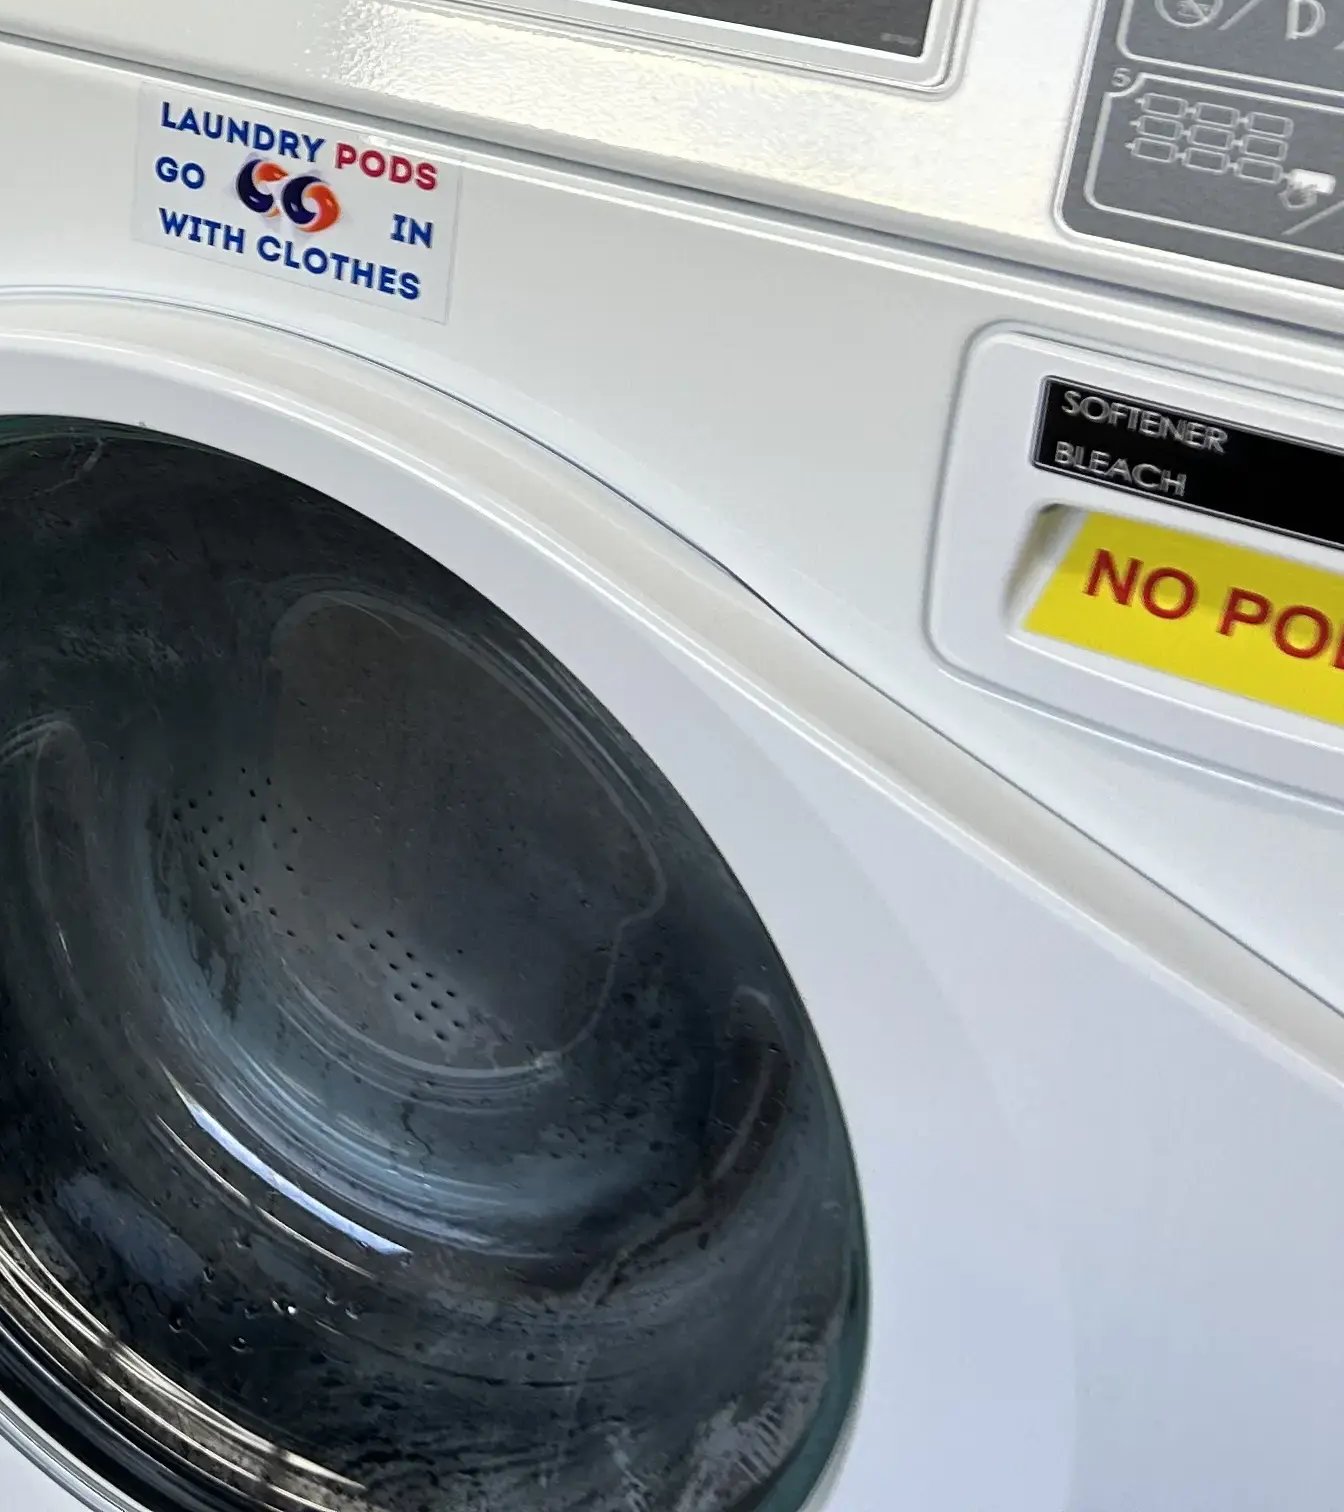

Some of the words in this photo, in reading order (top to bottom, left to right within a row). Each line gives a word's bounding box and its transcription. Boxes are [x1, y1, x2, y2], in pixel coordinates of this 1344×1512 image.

[1112, 67, 1131, 88] 5
[161, 101, 325, 163] LAUNDRY
[334, 142, 437, 191] PODS
[155, 155, 206, 190] GO
[389, 213, 435, 249] IN
[158, 207, 246, 254] WITH
[256, 235, 421, 300] CLOTHES
[1060, 389, 1229, 456] SOFTENER
[1053, 440, 1187, 497] BLEACH
[1081, 547, 1200, 620] NO
[1215, 585, 1344, 672] PO
